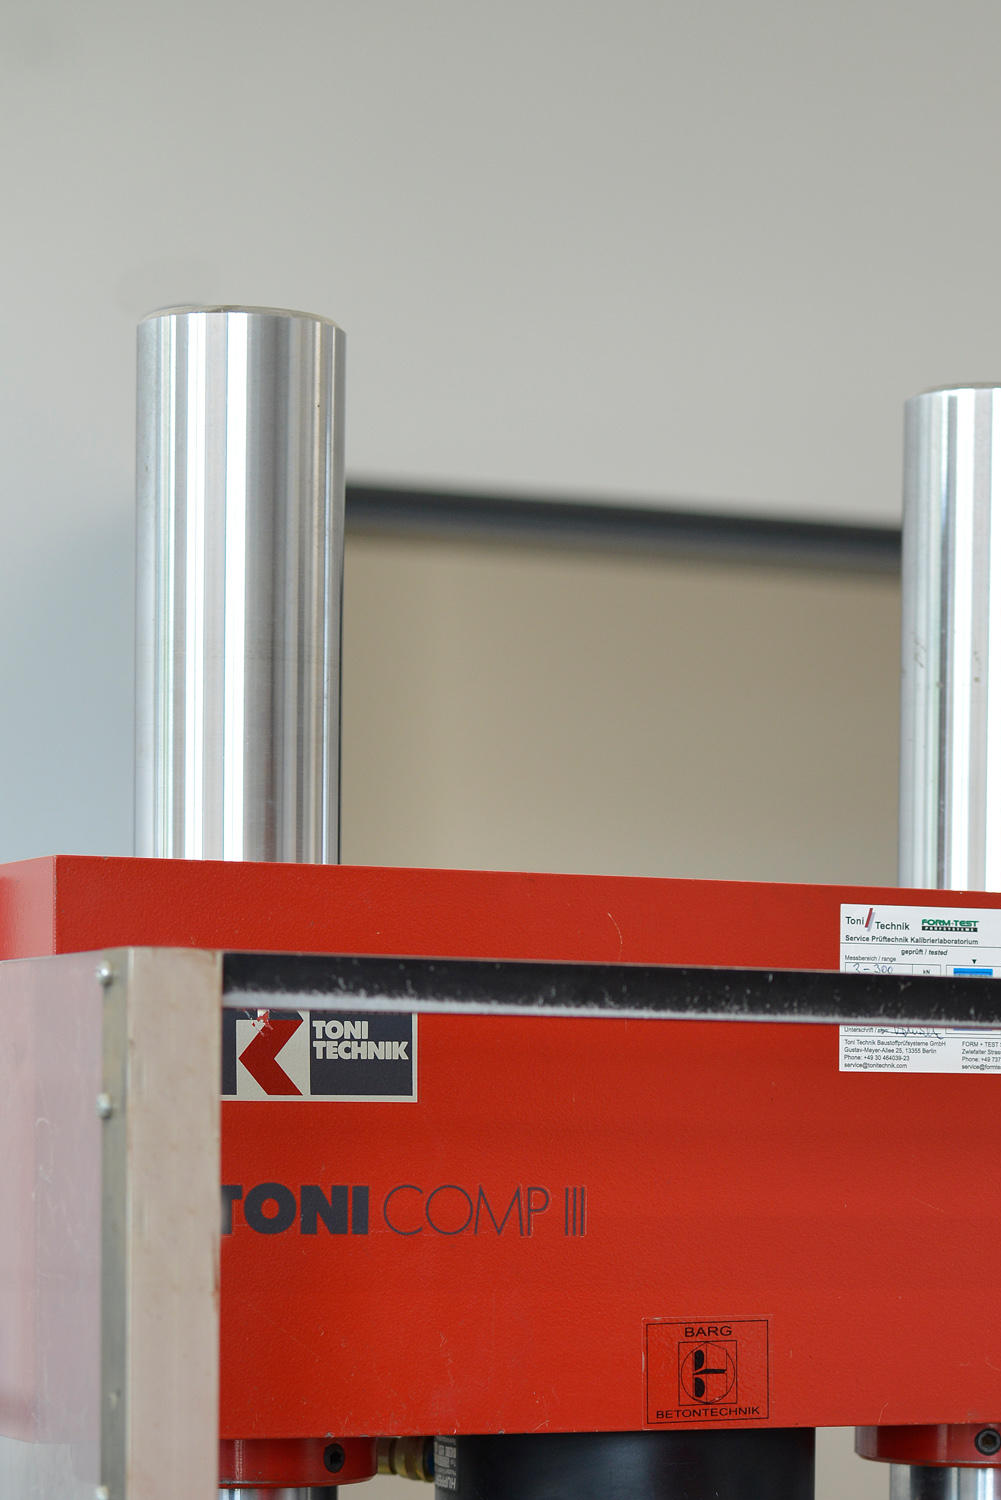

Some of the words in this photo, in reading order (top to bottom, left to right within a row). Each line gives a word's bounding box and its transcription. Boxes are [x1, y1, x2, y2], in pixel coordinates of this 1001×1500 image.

[845, 916, 864, 926] Toni
[875, 921, 910, 931] Technik
[845, 934, 870, 942] Service
[872, 935, 908, 943] Prüftechnik
[910, 936, 979, 945] Kalibrierlaboratorium
[900, 948, 924, 956] geprüft
[312, 1020, 369, 1040] TONI
[312, 1040, 409, 1060] TECHNIK
[383, 1183, 550, 1236] COMP
[684, 1326, 732, 1338] BARG
[656, 1406, 760, 1419] BETONTECHNIK
